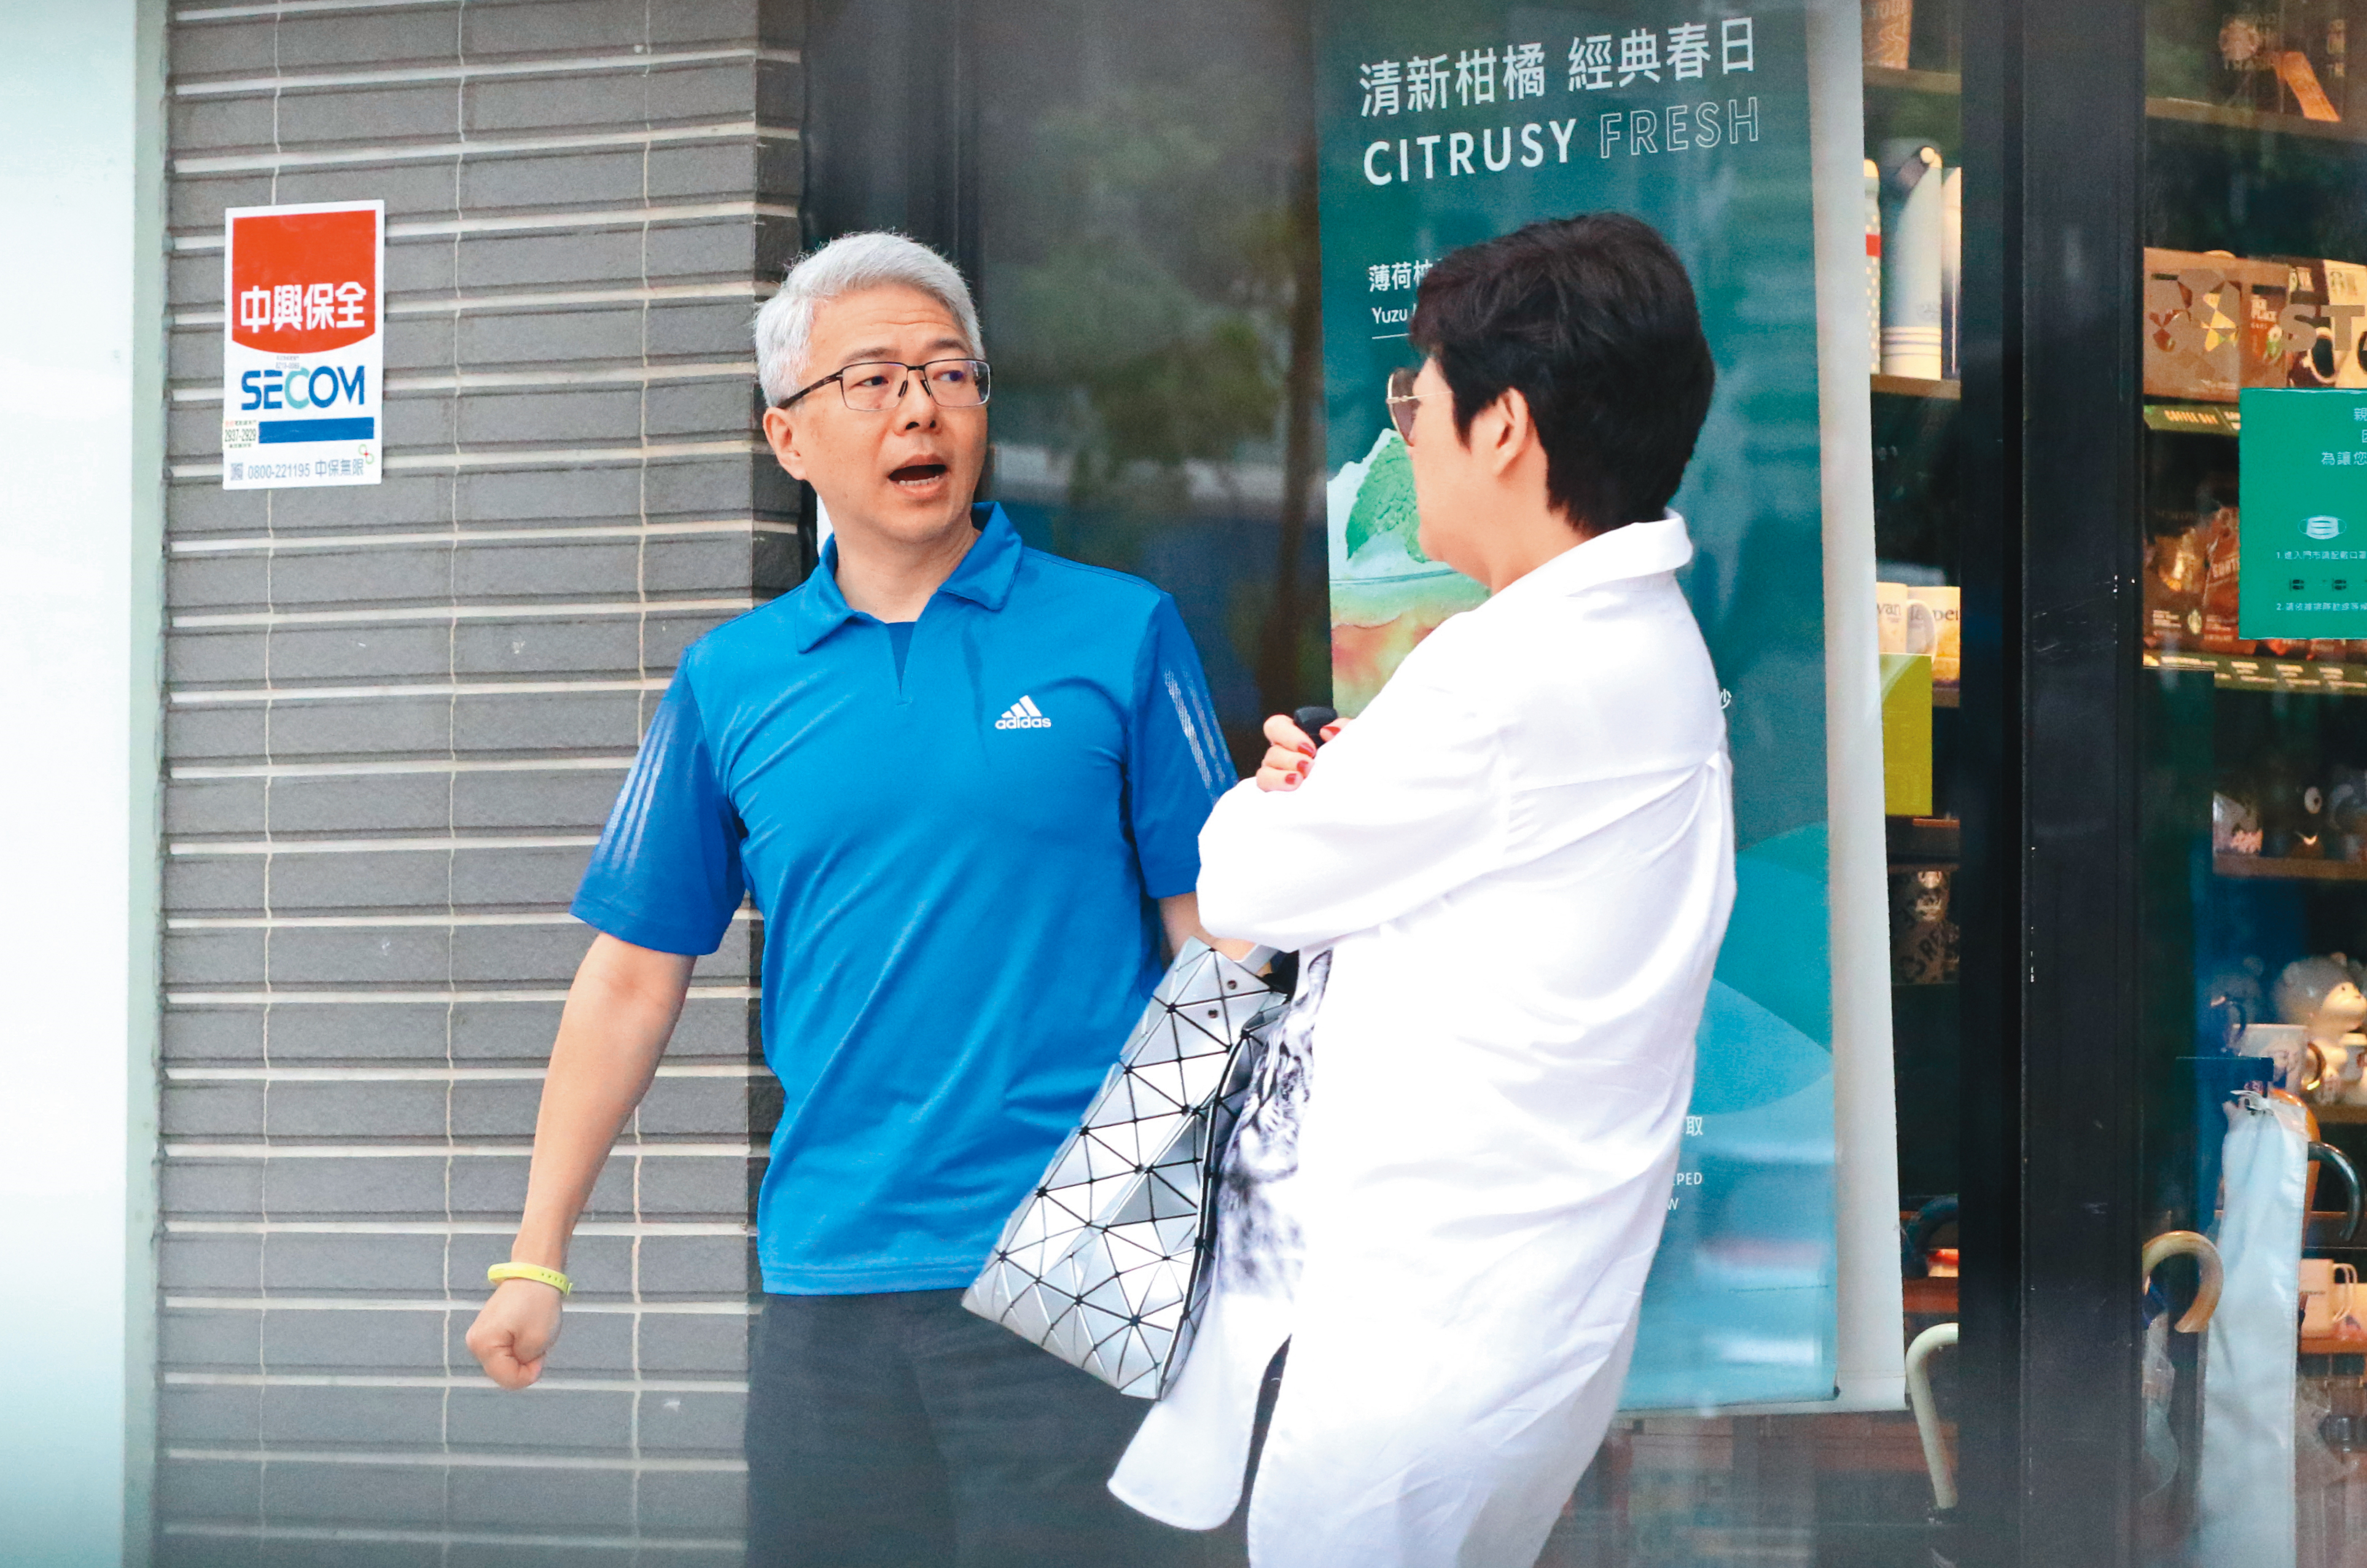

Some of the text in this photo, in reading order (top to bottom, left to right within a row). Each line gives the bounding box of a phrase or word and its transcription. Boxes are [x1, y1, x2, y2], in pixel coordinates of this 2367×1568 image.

[1359, 17, 1755, 119] 清新柑橘 經典春日
[1363, 96, 1759, 186] CITRUSY FRESH
[241, 282, 367, 333] 中興保全
[1371, 306, 1408, 324] Yuzu
[2279, 304, 2367, 352] ST
[241, 365, 365, 411] SECOM
[248, 458, 364, 479] 0800-221195 中保無限
[2322, 451, 2367, 466] 為讓您
[994, 716, 1051, 730] adidas
[1682, 1115, 1704, 1136] 取
[1672, 1172, 1703, 1186] PED
